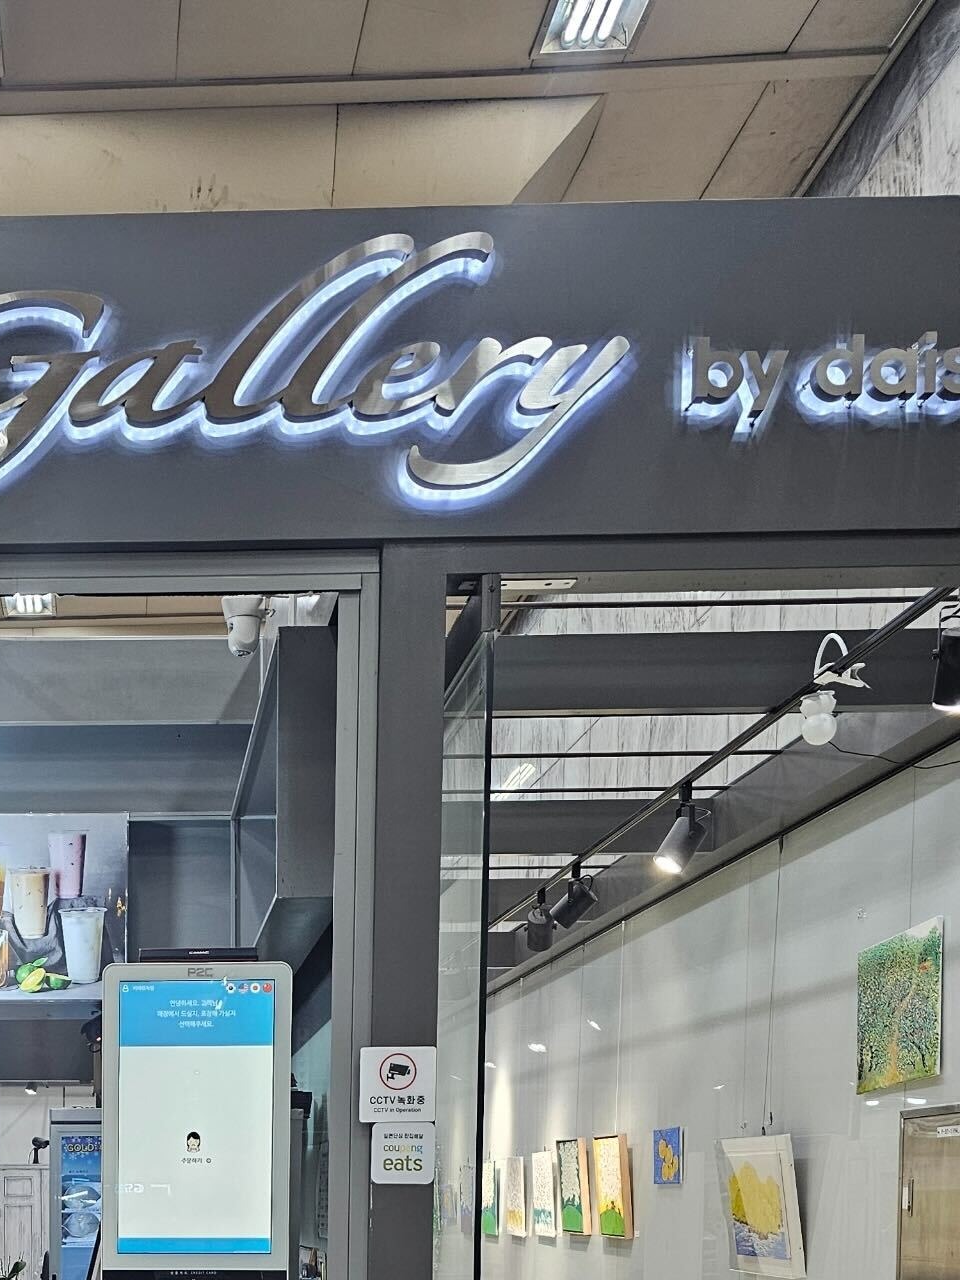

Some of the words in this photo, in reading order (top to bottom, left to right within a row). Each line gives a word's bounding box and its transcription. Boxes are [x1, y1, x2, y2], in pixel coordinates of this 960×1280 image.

[688, 336, 789, 416] by
[369, 1096, 396, 1105] CCTV
[383, 1155, 423, 1171] eats
